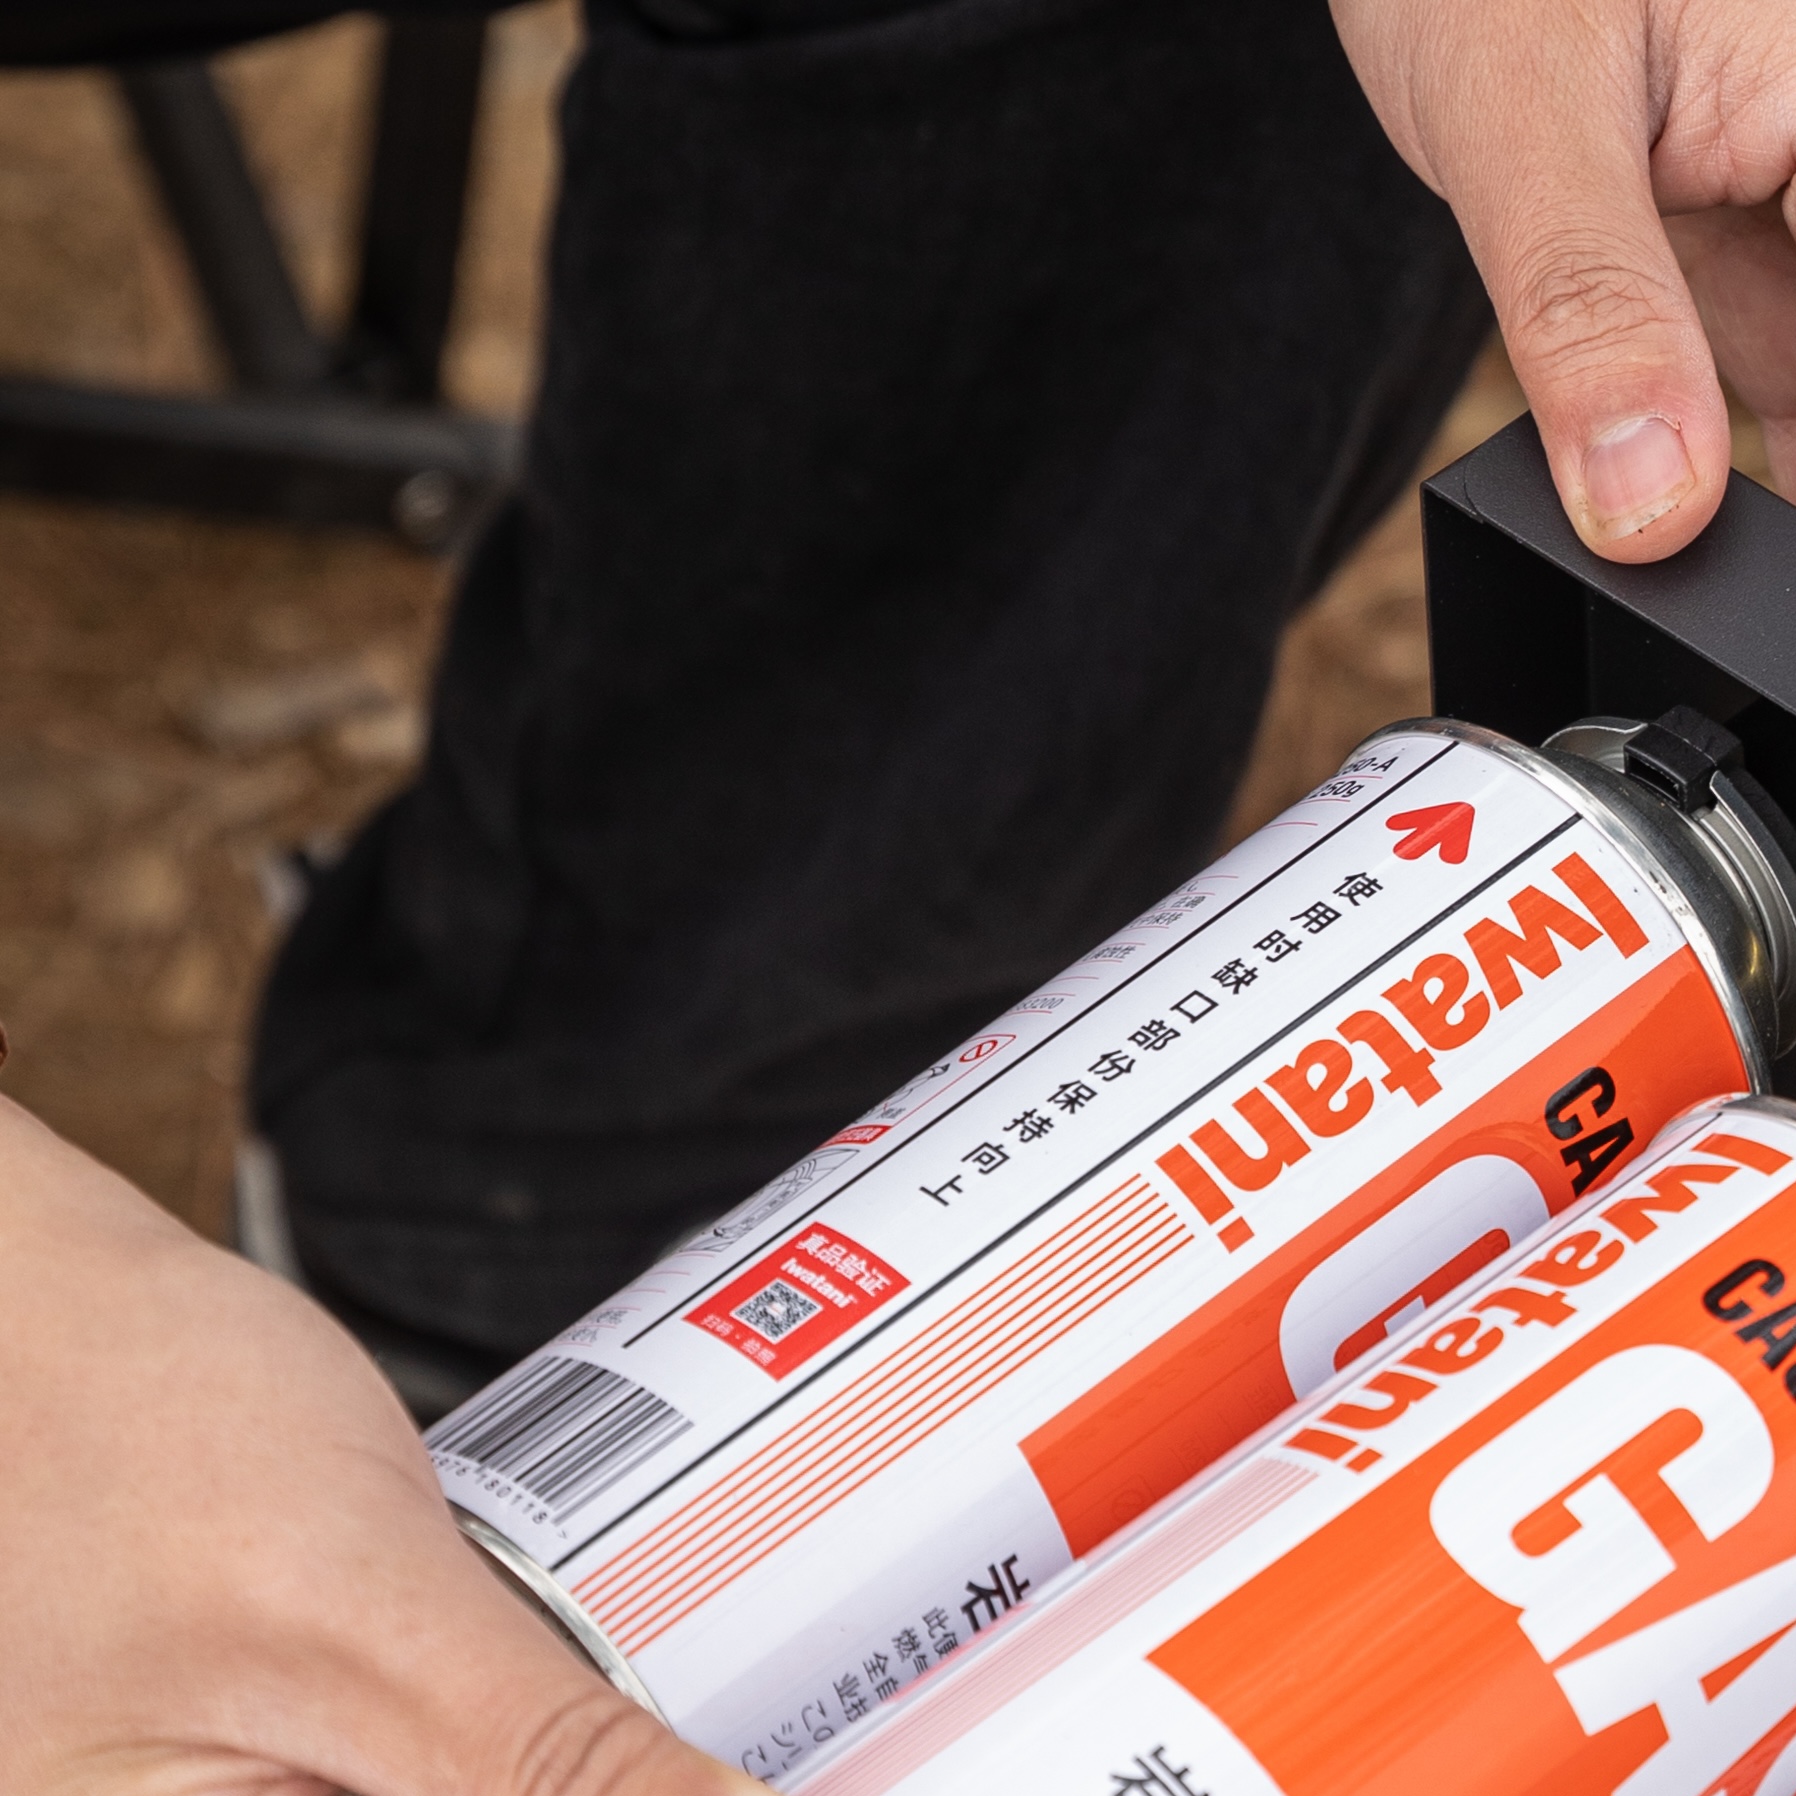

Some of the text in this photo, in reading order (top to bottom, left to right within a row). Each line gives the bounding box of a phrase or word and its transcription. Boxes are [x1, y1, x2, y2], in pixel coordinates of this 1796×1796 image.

[919, 871, 1384, 1206] 使用时缺口部份保持向上
[1154, 851, 1650, 1254] Iwatani
[780, 1257, 853, 1309] Iwatani
[795, 1231, 892, 1298] 真品验证
[1281, 1132, 1793, 1474] Iwatani
